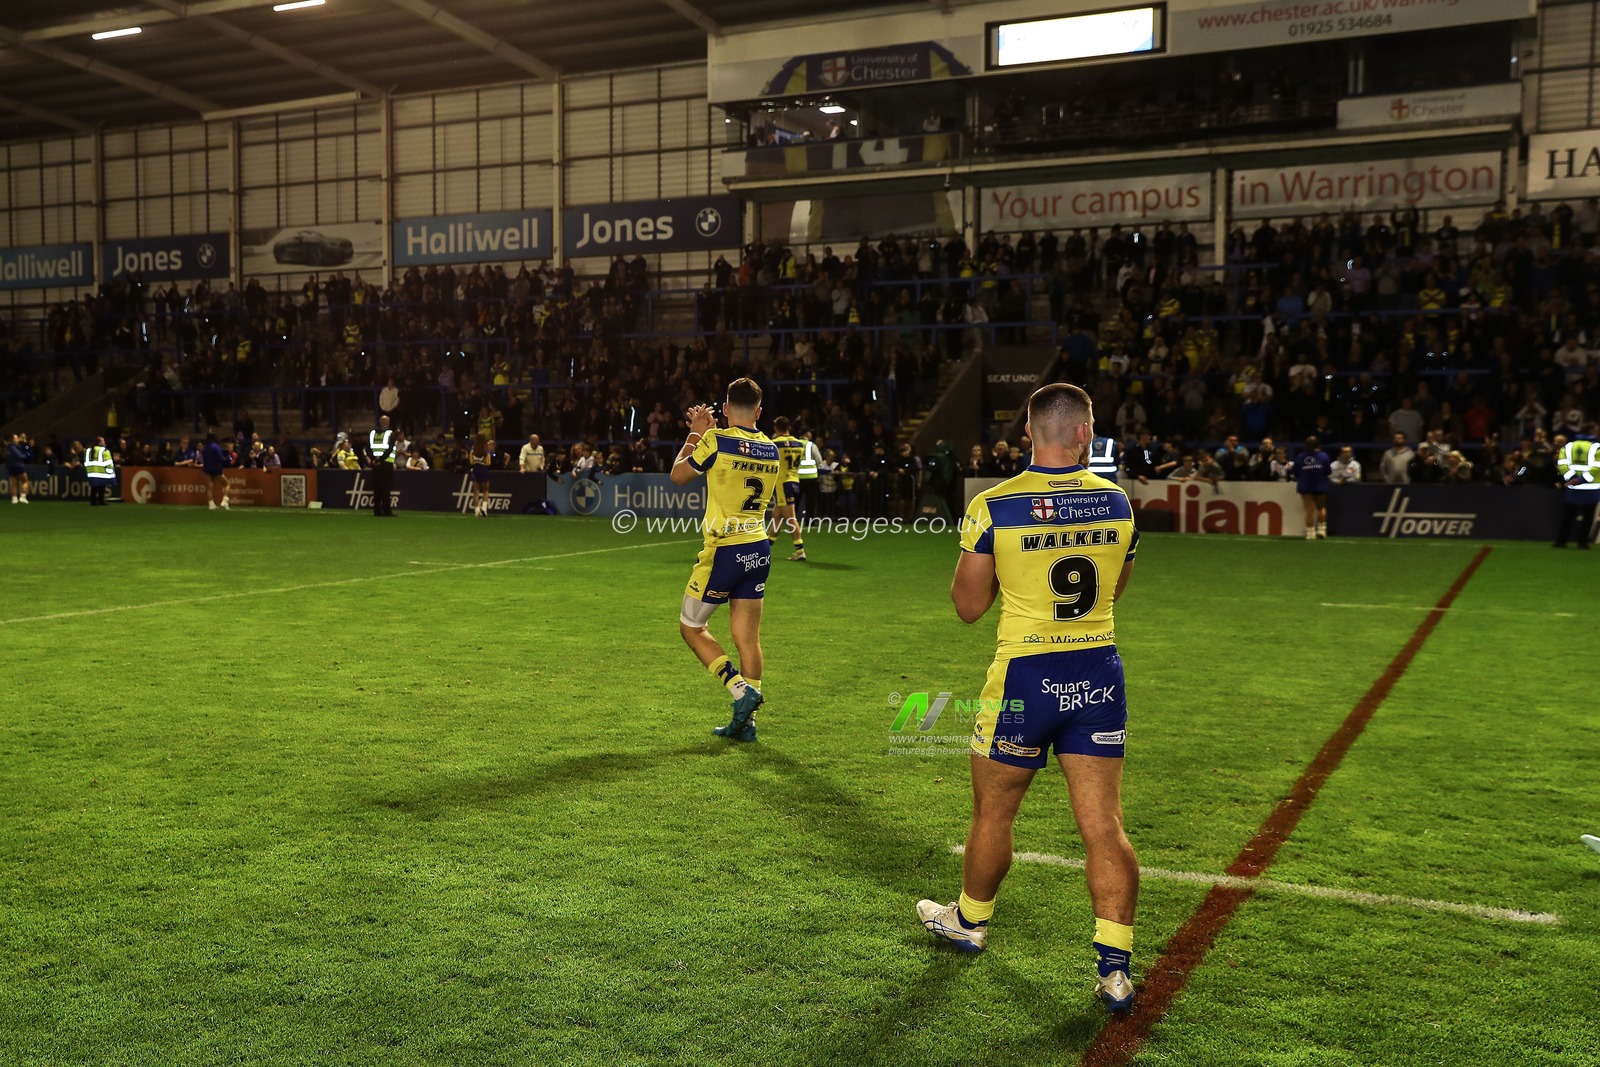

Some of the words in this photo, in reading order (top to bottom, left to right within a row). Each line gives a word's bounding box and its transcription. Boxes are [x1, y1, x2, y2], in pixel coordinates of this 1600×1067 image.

[1288, 20, 1334, 37] 01925
[851, 65, 918, 81] Chester
[1240, 175, 1270, 205] in
[1279, 164, 1495, 204] Warrington
[991, 190, 1062, 221] Your
[1071, 184, 1201, 218] campus
[407, 217, 539, 256] Halliwell
[576, 212, 675, 249] Jones
[113, 246, 183, 277] Jones
[986, 374, 1011, 383] SEAT
[1011, 374, 1040, 383] UNIQ
[62, 475, 113, 498] Jons
[161, 483, 207, 493] OVERFORD
[613, 482, 706, 511] Halliwel
[740, 476, 765, 513] 2
[1056, 495, 1098, 506] University
[1099, 494, 1108, 502] of
[1058, 505, 1111, 519] Chester
[1373, 487, 1477, 539] HOOVER
[1021, 529, 1119, 552] WALKER
[736, 552, 759, 564] Square
[744, 555, 770, 572] BRICK
[1048, 554, 1099, 622] 9
[1041, 679, 1091, 697] Square
[1059, 685, 1115, 712] BRICK
